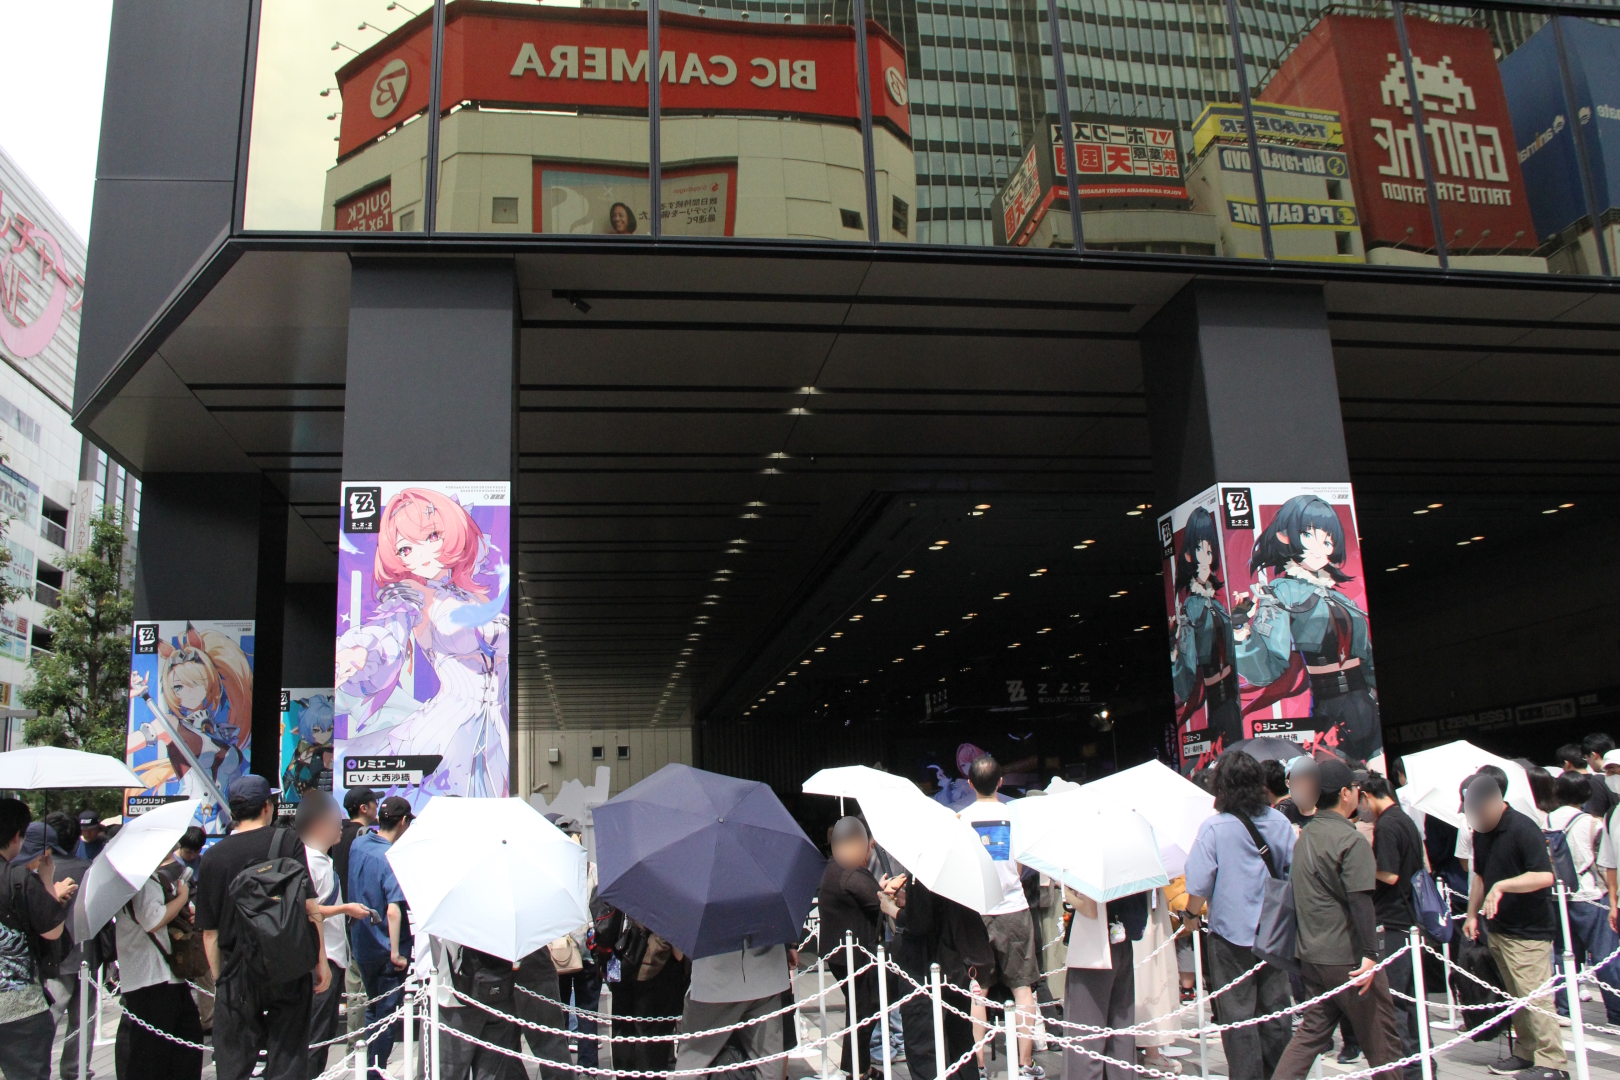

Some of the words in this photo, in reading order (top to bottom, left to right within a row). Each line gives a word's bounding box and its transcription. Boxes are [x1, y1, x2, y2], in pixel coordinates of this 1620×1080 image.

[1262, 721, 1294, 731] ジェーン
[357, 759, 406, 769] レミエール
